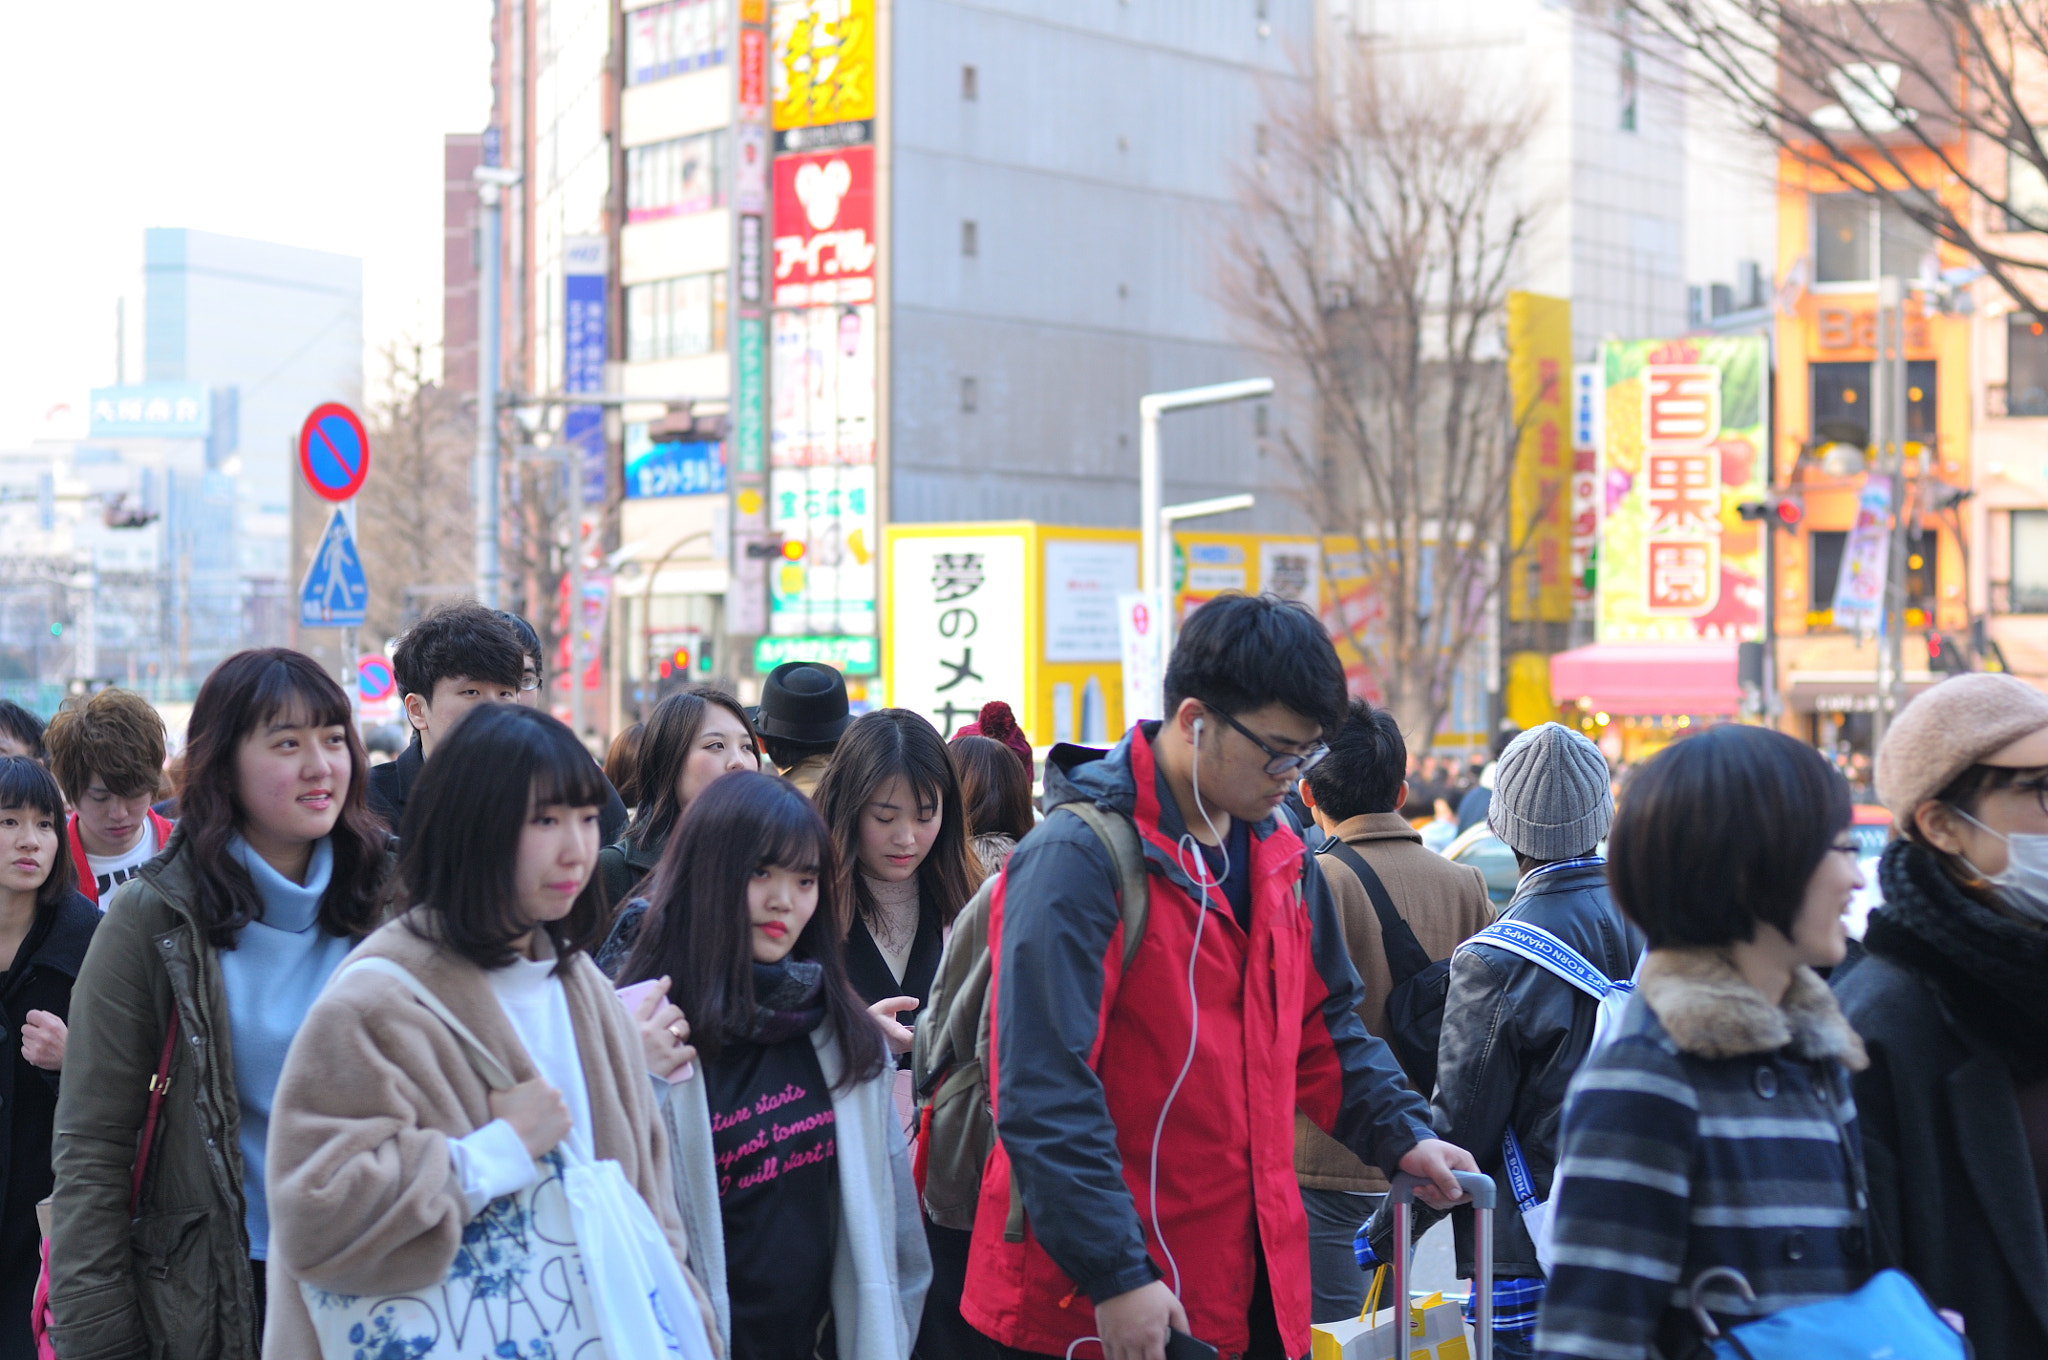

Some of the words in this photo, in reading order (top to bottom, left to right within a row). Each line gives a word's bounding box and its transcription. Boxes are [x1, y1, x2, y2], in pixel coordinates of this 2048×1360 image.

[1646, 368, 1719, 615] 百果園
[1503, 928, 1553, 953] CHAMPS
[1552, 950, 1585, 975] BORN
[755, 1083, 806, 1115] starts
[738, 1156, 778, 1189] will
[783, 1142, 824, 1173] start
[1509, 1157, 1525, 1192] BORN
